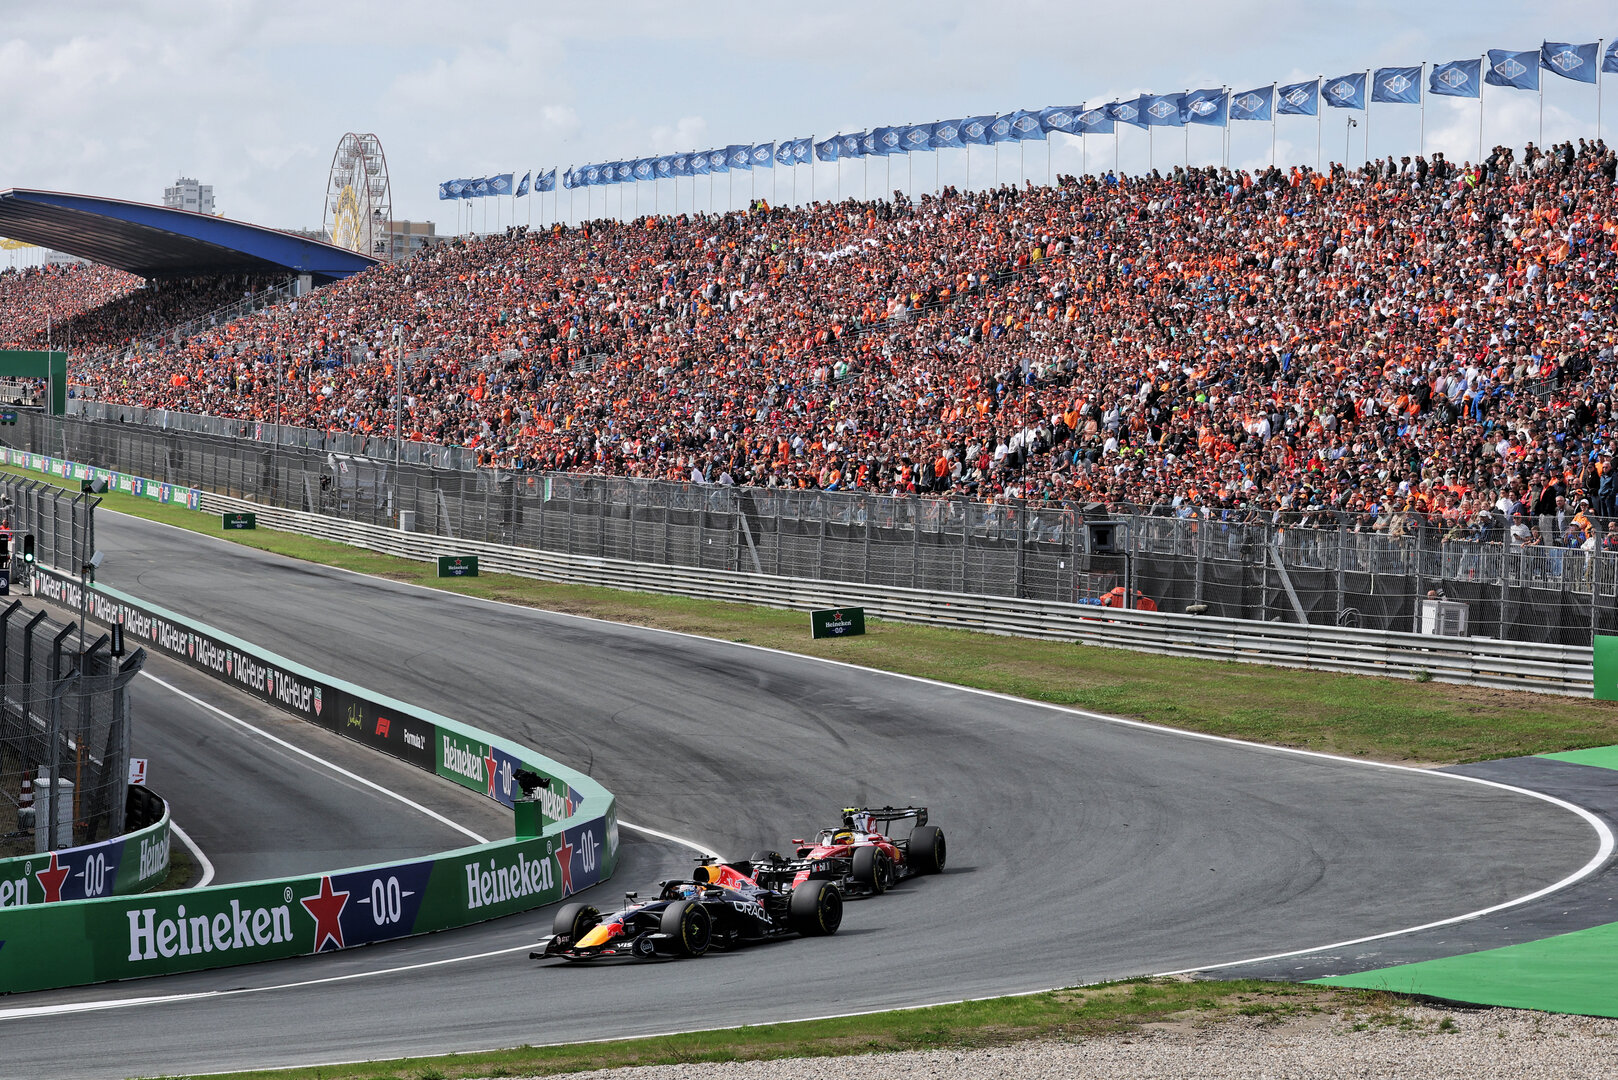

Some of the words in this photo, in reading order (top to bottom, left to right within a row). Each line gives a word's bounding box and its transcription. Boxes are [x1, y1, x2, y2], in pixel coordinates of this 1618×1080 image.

[825, 620, 852, 628] Heineken
[443, 735, 483, 782] Heineken
[84, 852, 105, 897] 0.0
[126, 899, 293, 962] Heineken
[371, 876, 401, 926] 0.0
[465, 852, 554, 909] Heineken
[581, 829, 596, 873] 0.0
[733, 901, 773, 924] ORACLE
